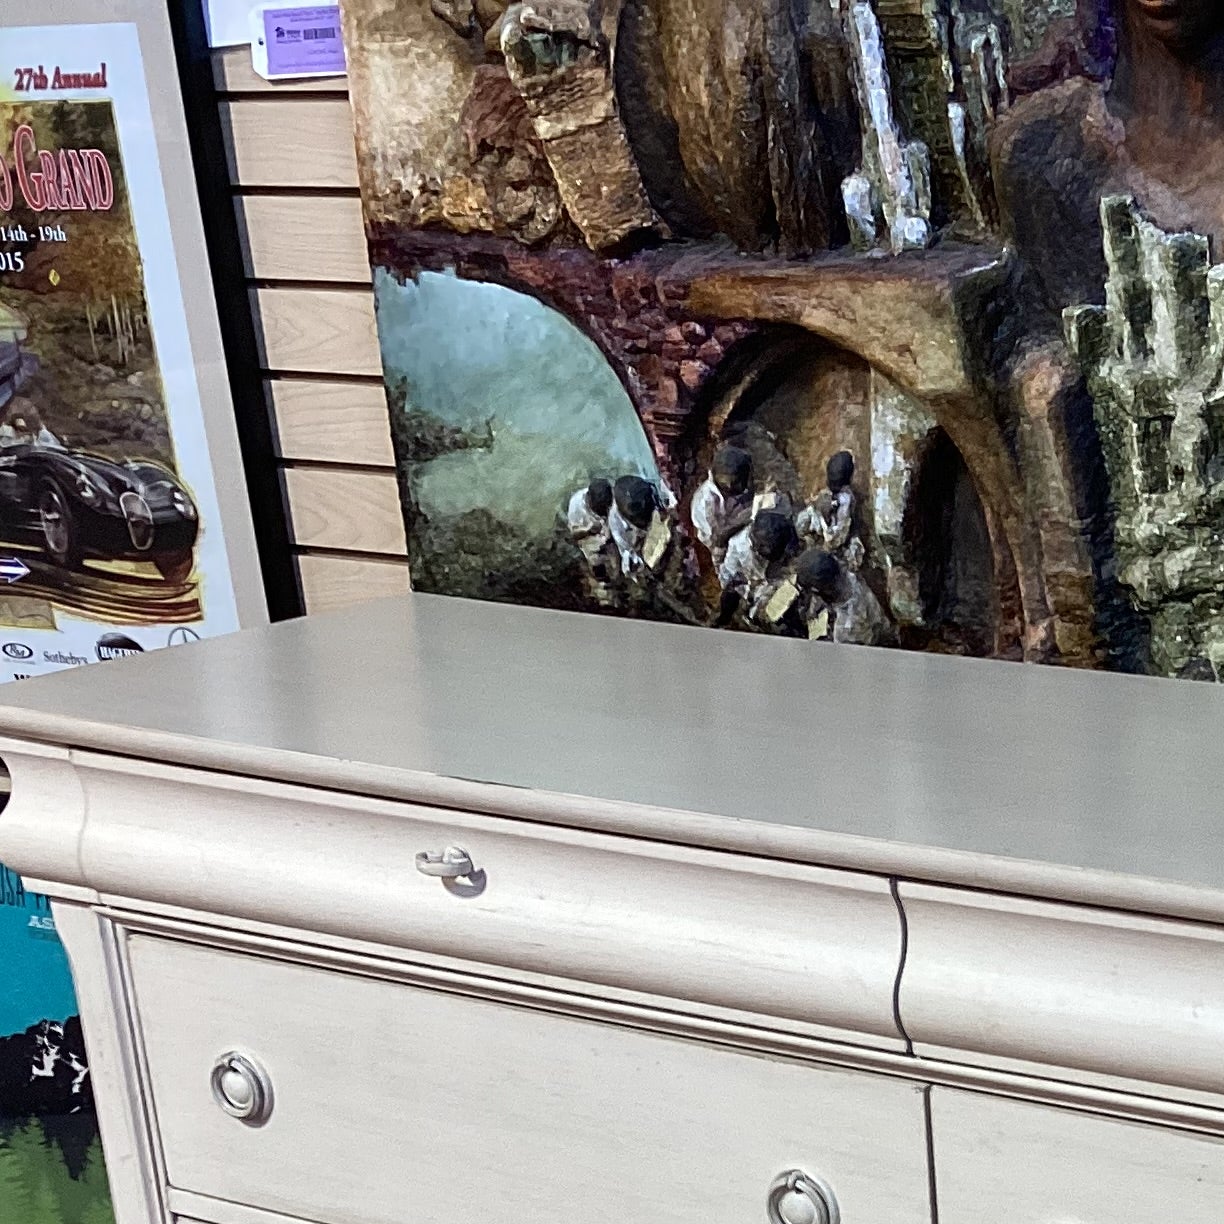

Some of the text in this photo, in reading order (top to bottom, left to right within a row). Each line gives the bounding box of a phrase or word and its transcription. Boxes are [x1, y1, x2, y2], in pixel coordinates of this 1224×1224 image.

[14, 62, 107, 91] 27th Annual
[38, 224, 67, 242] 19th
